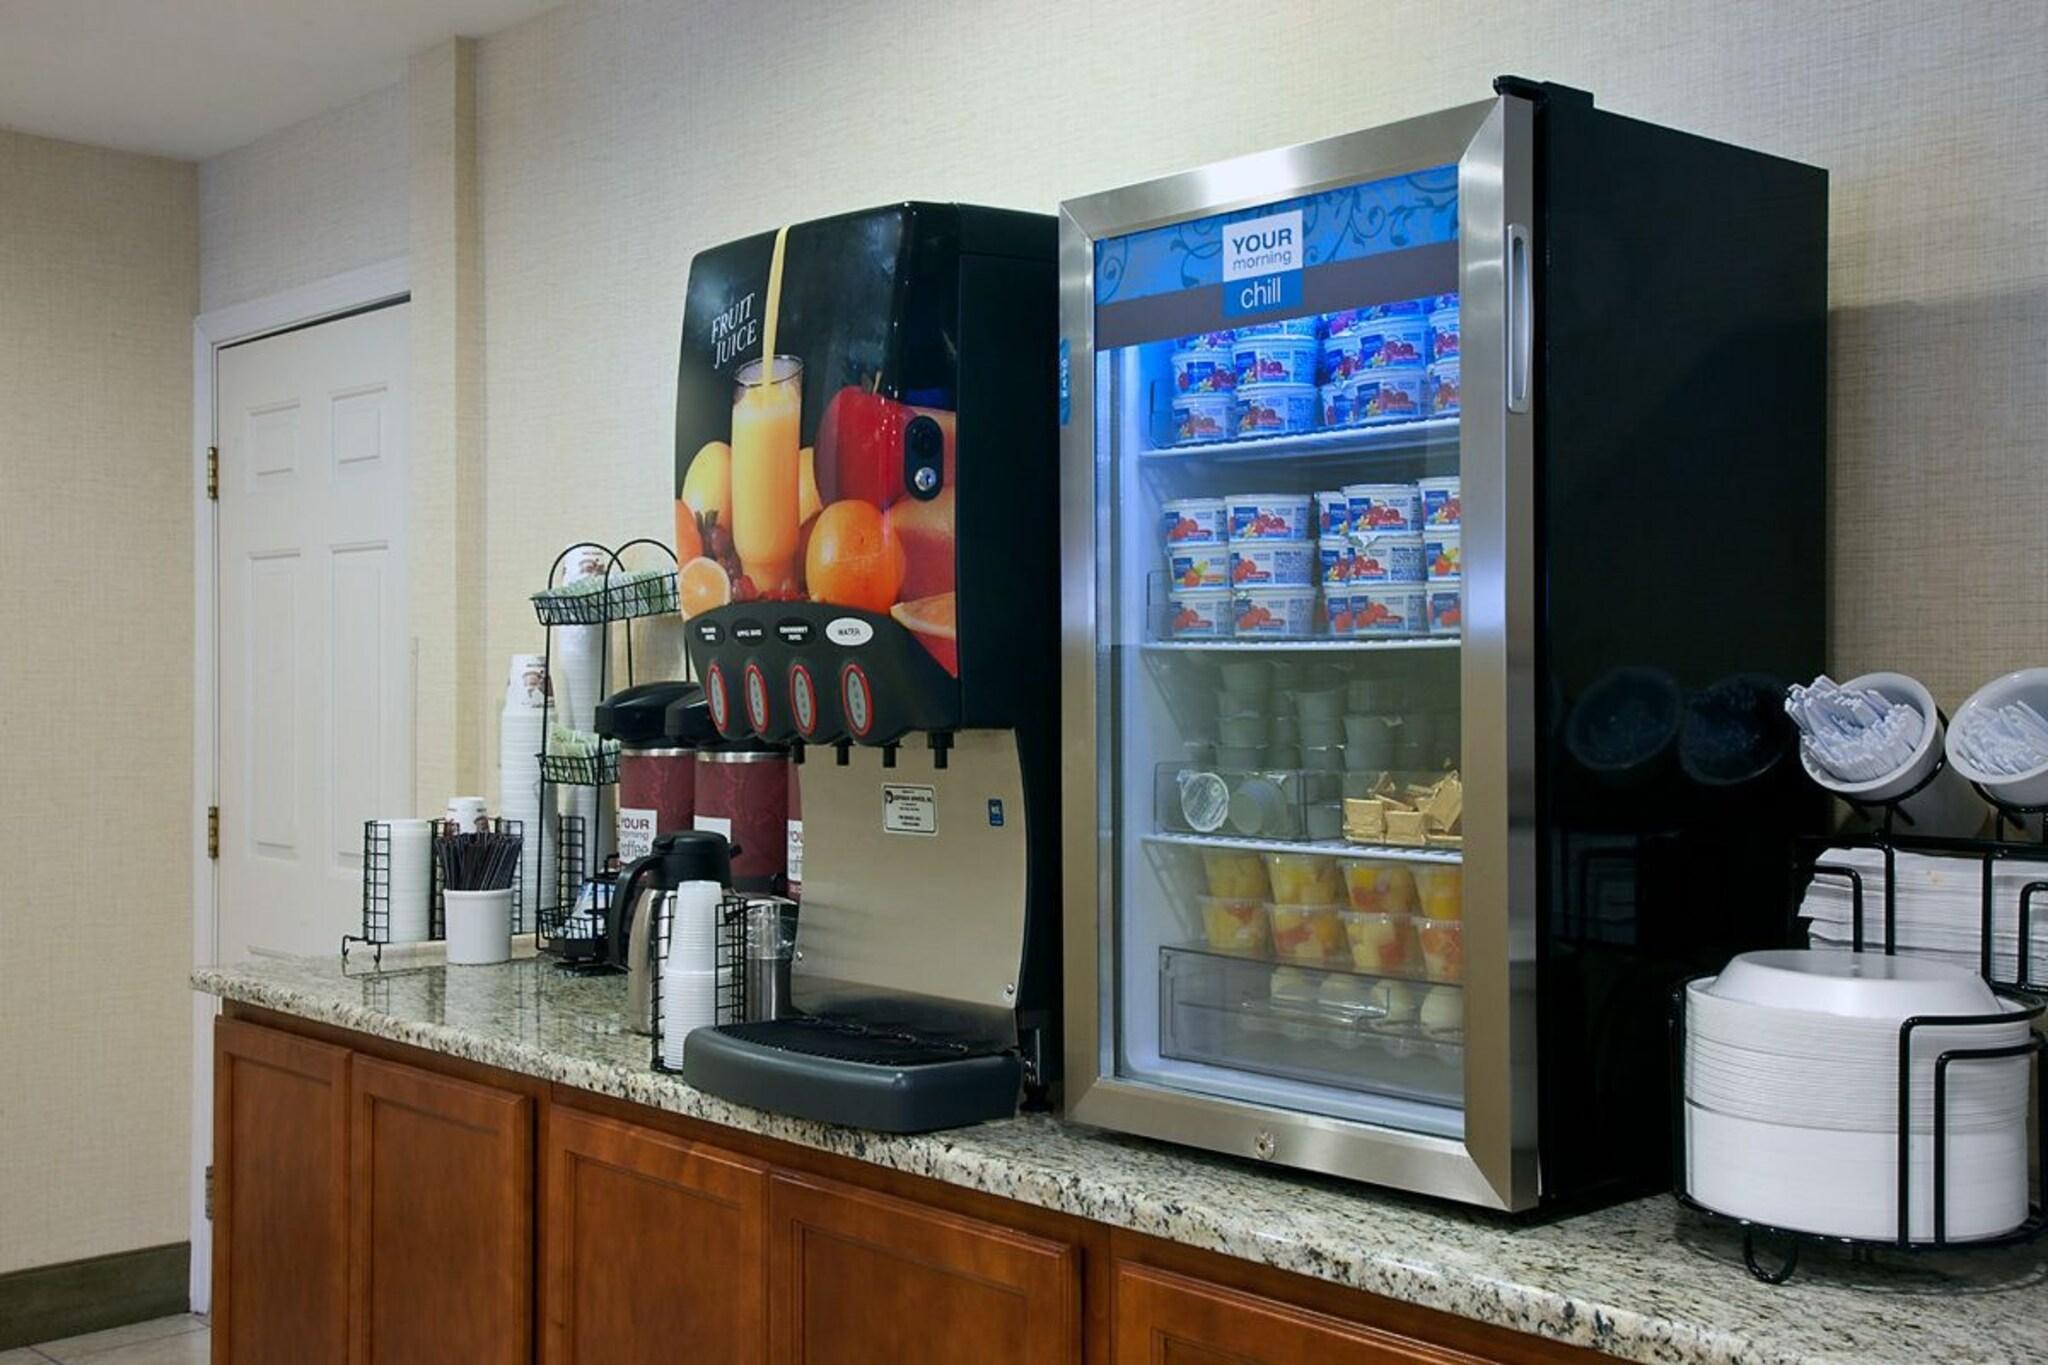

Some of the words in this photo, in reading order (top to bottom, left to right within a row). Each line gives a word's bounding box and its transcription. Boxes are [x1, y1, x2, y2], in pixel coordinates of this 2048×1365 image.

[1231, 228, 1292, 255] YOUR
[1232, 250, 1292, 271] morning
[1240, 276, 1281, 309] chill
[711, 292, 756, 345] FRUIT
[713, 318, 757, 370] JUICE
